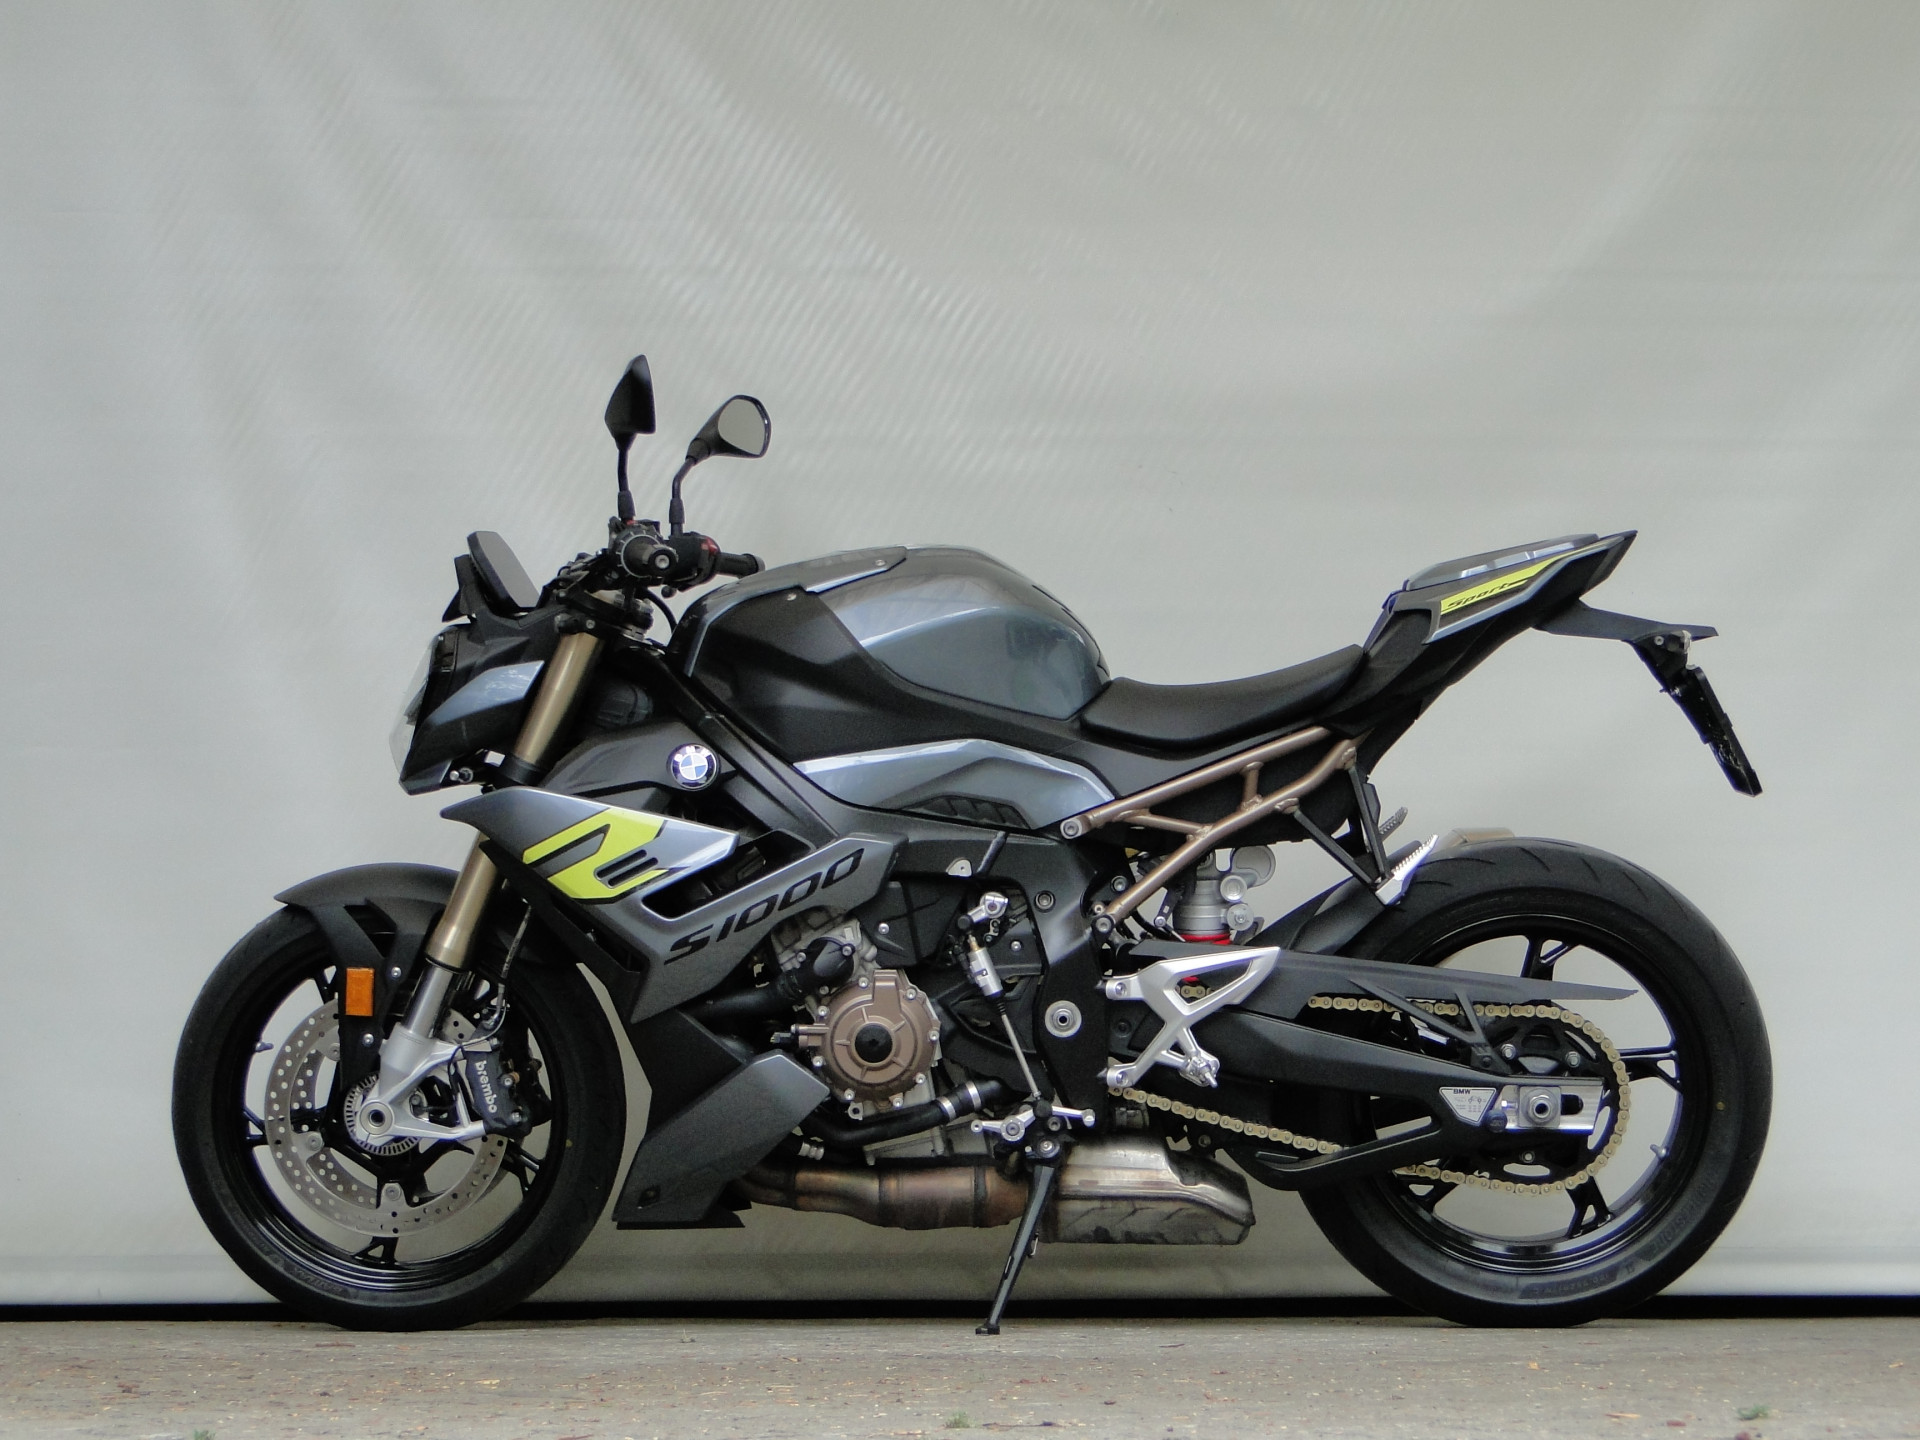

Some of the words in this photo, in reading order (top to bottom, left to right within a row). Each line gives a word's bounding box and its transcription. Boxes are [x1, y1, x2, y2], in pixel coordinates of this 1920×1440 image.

[1447, 582, 1511, 608] Sport
[674, 745, 712, 763] BMW
[664, 847, 865, 966] S1000
[474, 1059, 498, 1114] brembo
